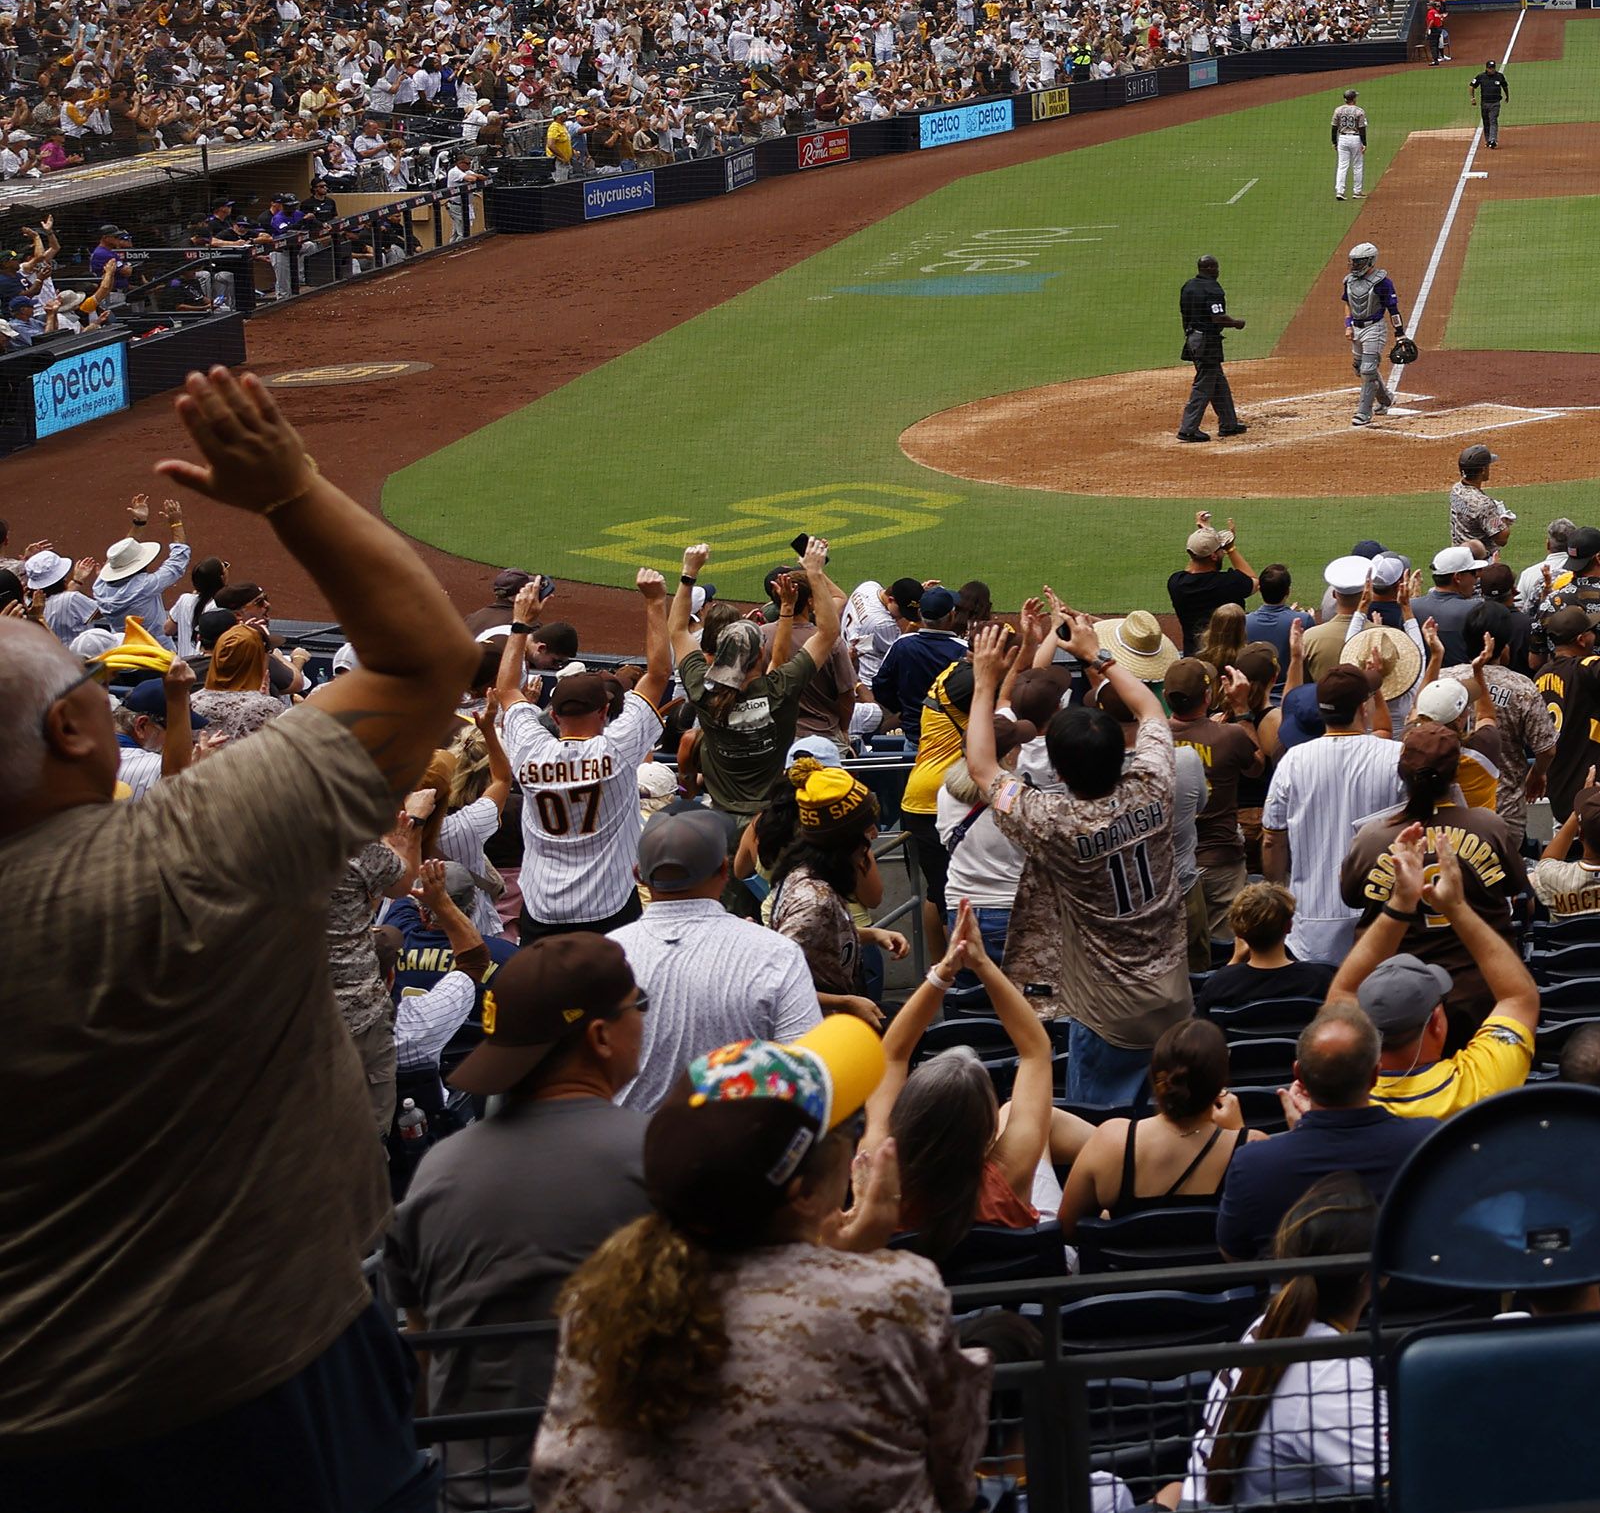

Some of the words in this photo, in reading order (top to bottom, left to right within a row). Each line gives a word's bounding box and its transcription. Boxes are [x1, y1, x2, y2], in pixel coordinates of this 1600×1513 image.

[930, 113, 960, 140] petco
[979, 106, 1007, 125] petco
[802, 142, 829, 166] Roma
[587, 183, 642, 208] citycruises
[186, 251, 198, 260] us
[51, 356, 115, 418] petco
[61, 403, 80, 420] where
[81, 399, 92, 414] the
[92, 396, 107, 411] pets
[107, 393, 117, 405] go
[520, 755, 613, 786] ESCALERA
[533, 787, 601, 836] 07
[1076, 800, 1165, 862] DARVISH
[1107, 839, 1156, 919] 11
